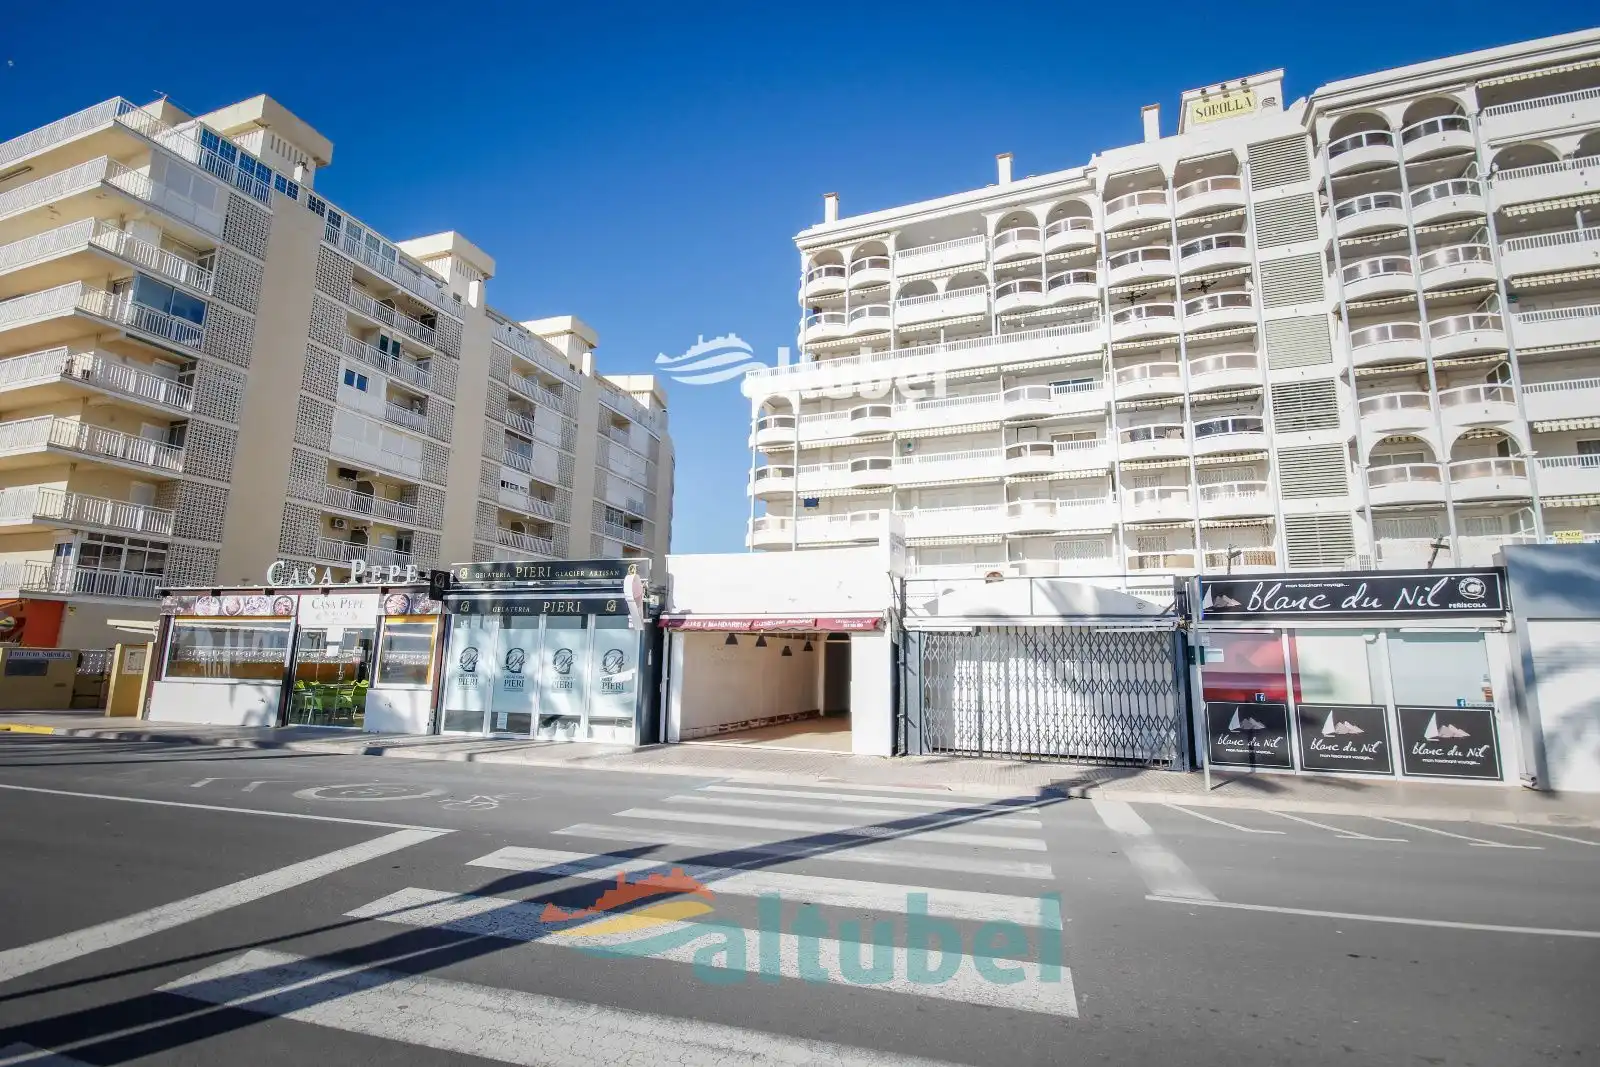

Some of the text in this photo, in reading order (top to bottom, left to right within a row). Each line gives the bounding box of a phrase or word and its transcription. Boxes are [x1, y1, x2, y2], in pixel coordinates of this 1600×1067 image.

[1196, 97, 1252, 117] SOROLLA
[266, 558, 419, 586] CASA PEPE
[515, 566, 551, 578] PIERI
[588, 569, 620, 577] ARTISAN
[1341, 582, 1382, 608] du
[1393, 576, 1449, 610] Nil
[311, 597, 365, 610] CASA PEPE
[543, 601, 581, 612] PIERI
[458, 678, 478, 686] PIERI
[504, 679, 524, 688] PIERI
[601, 681, 624, 690] PIERI
[1263, 736, 1283, 748] Nil
[1310, 737, 1383, 753] blanc du Nil
[1412, 741, 1490, 758] blanc du Nil
